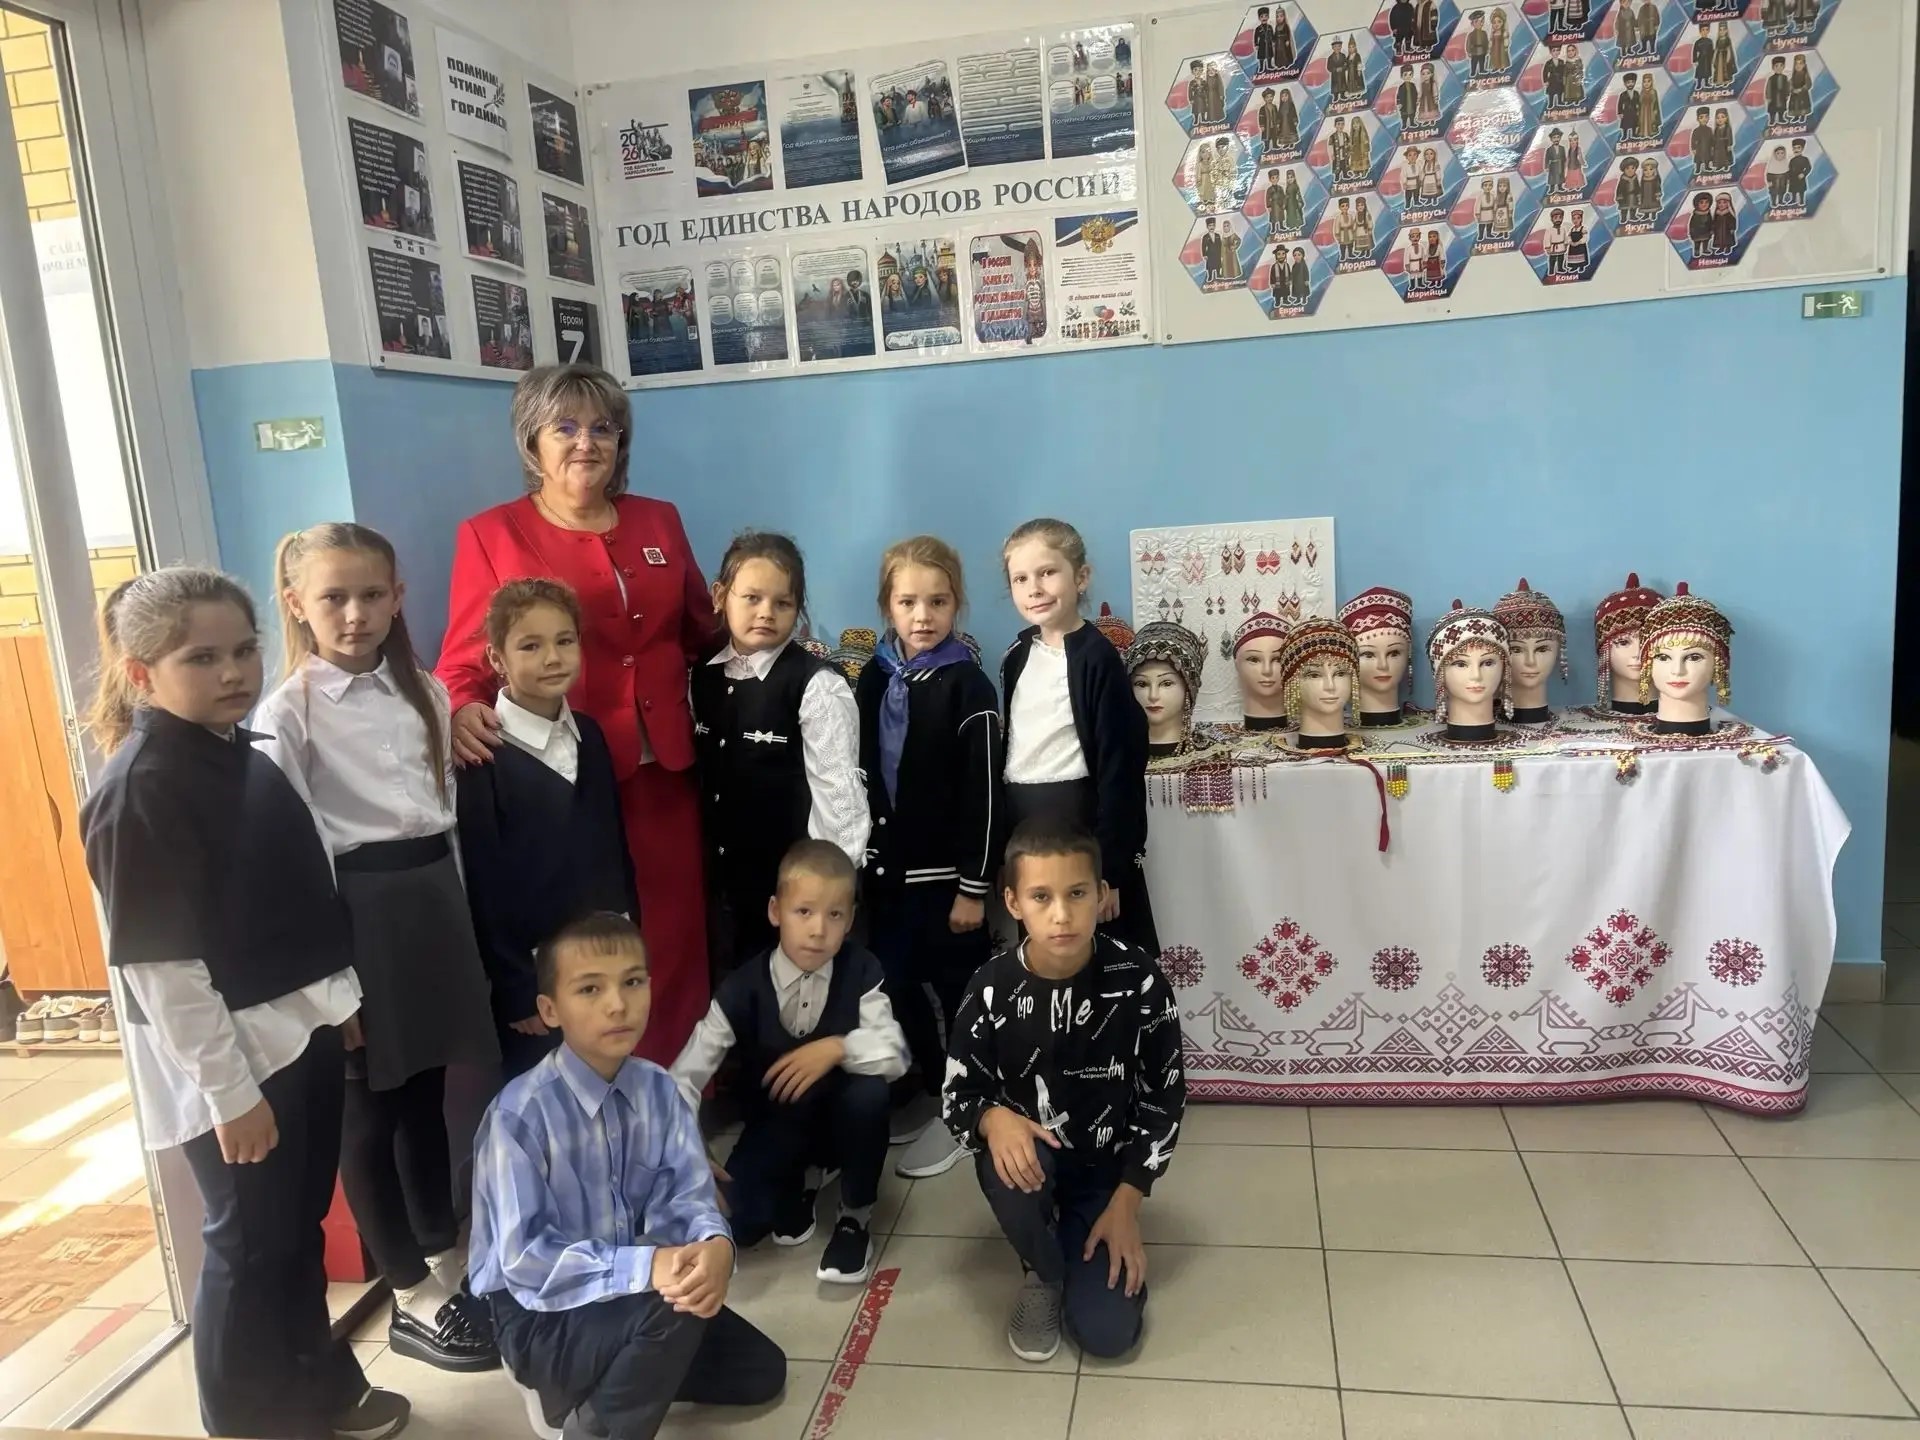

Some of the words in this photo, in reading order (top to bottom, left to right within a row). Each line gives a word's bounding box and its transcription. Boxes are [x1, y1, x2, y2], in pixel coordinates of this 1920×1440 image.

[1697, 10, 1739, 20] Калмыки
[1552, 32, 1585, 42] Карелы
[1773, 36, 1807, 47] Чукчи
[1403, 53, 1431, 62] Манси
[447, 56, 498, 87] ПОМНИМ!
[449, 75, 486, 98] ЧТИМ!
[1469, 75, 1511, 88] Русские
[620, 132, 638, 147] 20
[1401, 127, 1439, 140] Татары
[1616, 138, 1663, 150] Балкарцы
[622, 147, 639, 161] 26
[1260, 149, 1301, 161] Башкиры
[1332, 180, 1373, 191] Таджики
[1550, 193, 1583, 203] Казахи
[616, 221, 670, 248] ГОД
[680, 203, 831, 243] ЕДИНСТВА
[841, 188, 982, 223] НАРОДОВ
[993, 171, 1121, 207] РОССИИ
[1400, 208, 1447, 221] Белорусы
[1624, 222, 1655, 234] Якуты
[1274, 230, 1301, 241] Адыги
[1474, 240, 1515, 251] Чуваши
[1339, 260, 1376, 271] Мордва
[1555, 274, 1579, 282] Коми
[1407, 289, 1447, 299] Марийцы
[1279, 307, 1305, 315] Евреи
[560, 312, 583, 327] Героям
[561, 330, 585, 365] 7
[1051, 987, 1094, 1034] Me
[1088, 1124, 1096, 1132] No
[1094, 1104, 1113, 1124] Concord
